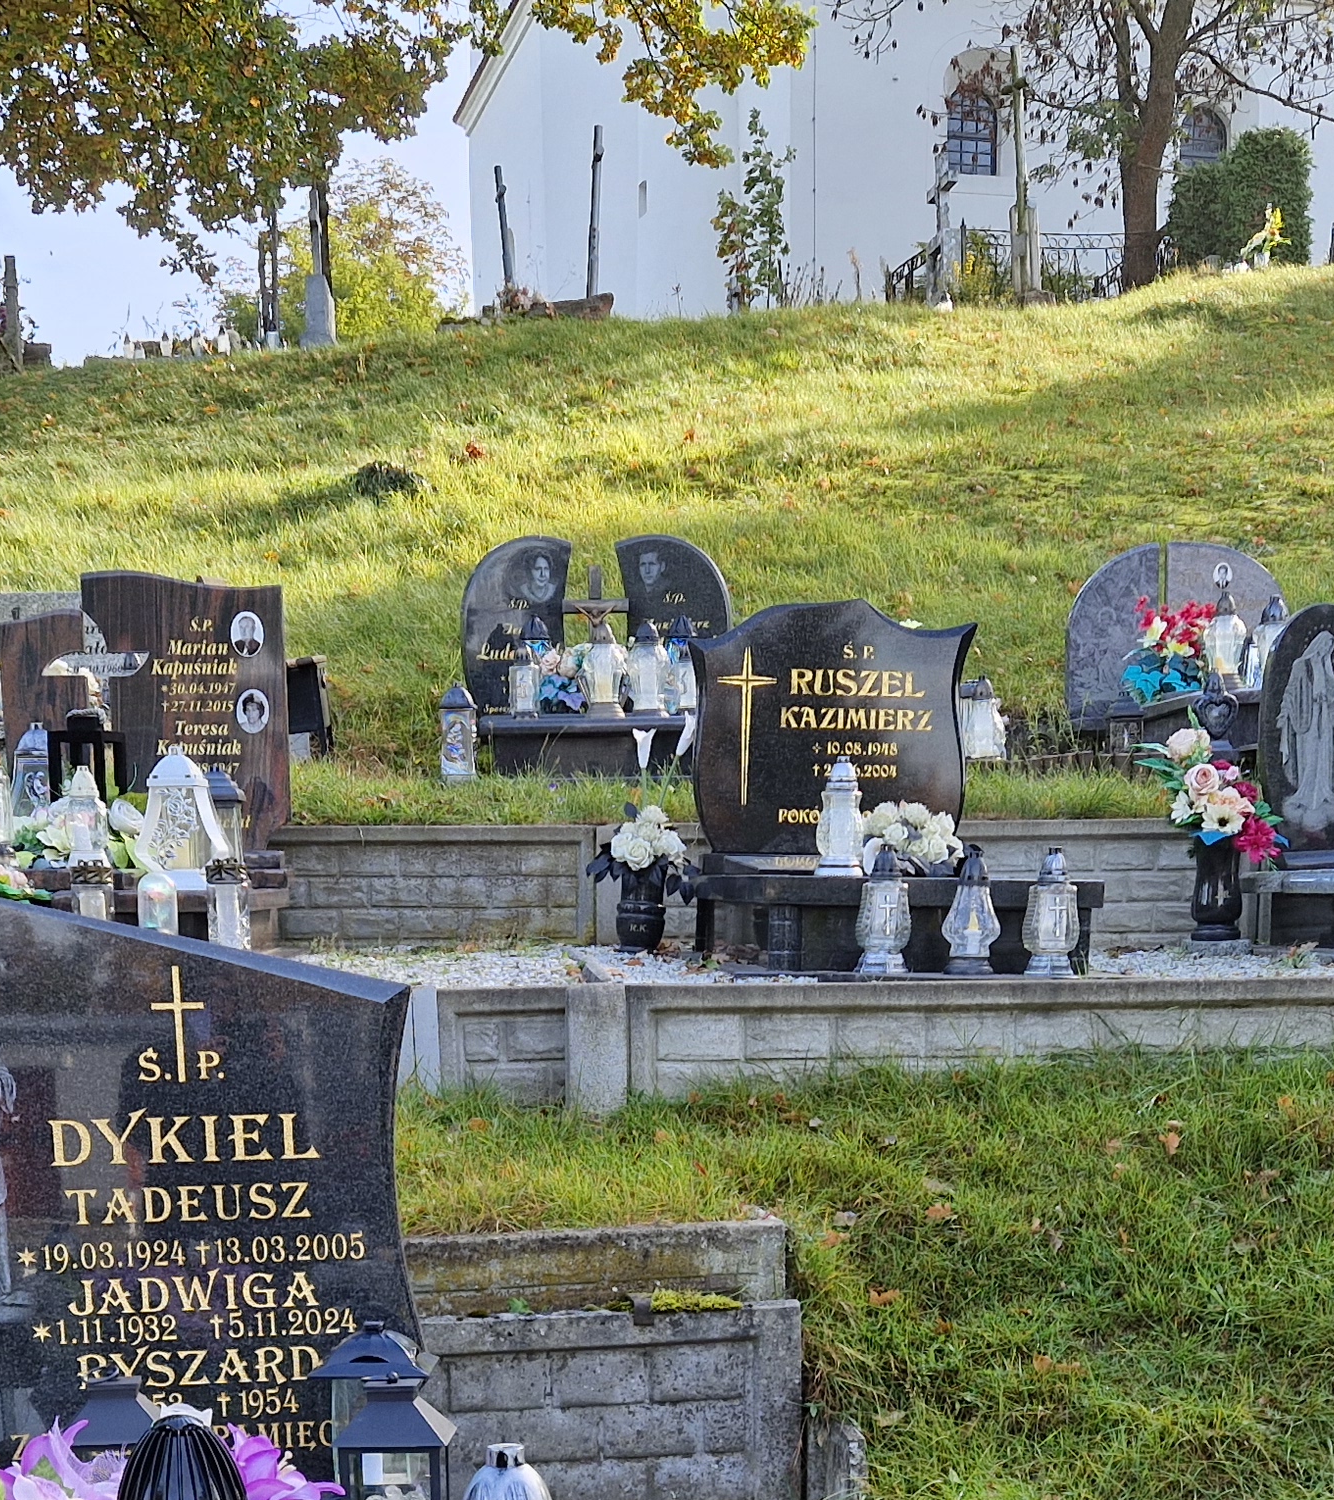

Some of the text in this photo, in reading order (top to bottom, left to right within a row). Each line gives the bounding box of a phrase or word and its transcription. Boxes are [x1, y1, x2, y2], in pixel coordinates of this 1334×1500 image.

[189, 616, 213, 631] Ś.P.
[167, 640, 229, 656] Marian
[151, 658, 238, 680] Kapuśniak
[790, 668, 927, 698] RUSZEL
[175, 720, 229, 736] Teresa
[779, 706, 933, 731] KAZIMIERZ
[823, 765, 898, 778] 2.6.2004
[778, 806, 821, 824] POKÓ
[197, 1050, 226, 1081] P.
[47, 1107, 321, 1167] DYKIEL
[64, 1181, 312, 1226] TADEUSZ
[41, 1230, 366, 1274] 19.03.1924 13.03.2005
[67, 1268, 320, 1317] JADWIGA
[56, 1307, 358, 1345] 1.11.1932 5.11.2024
[75, 1344, 320, 1390] RYSZARD
[240, 1388, 300, 1418] 1954
